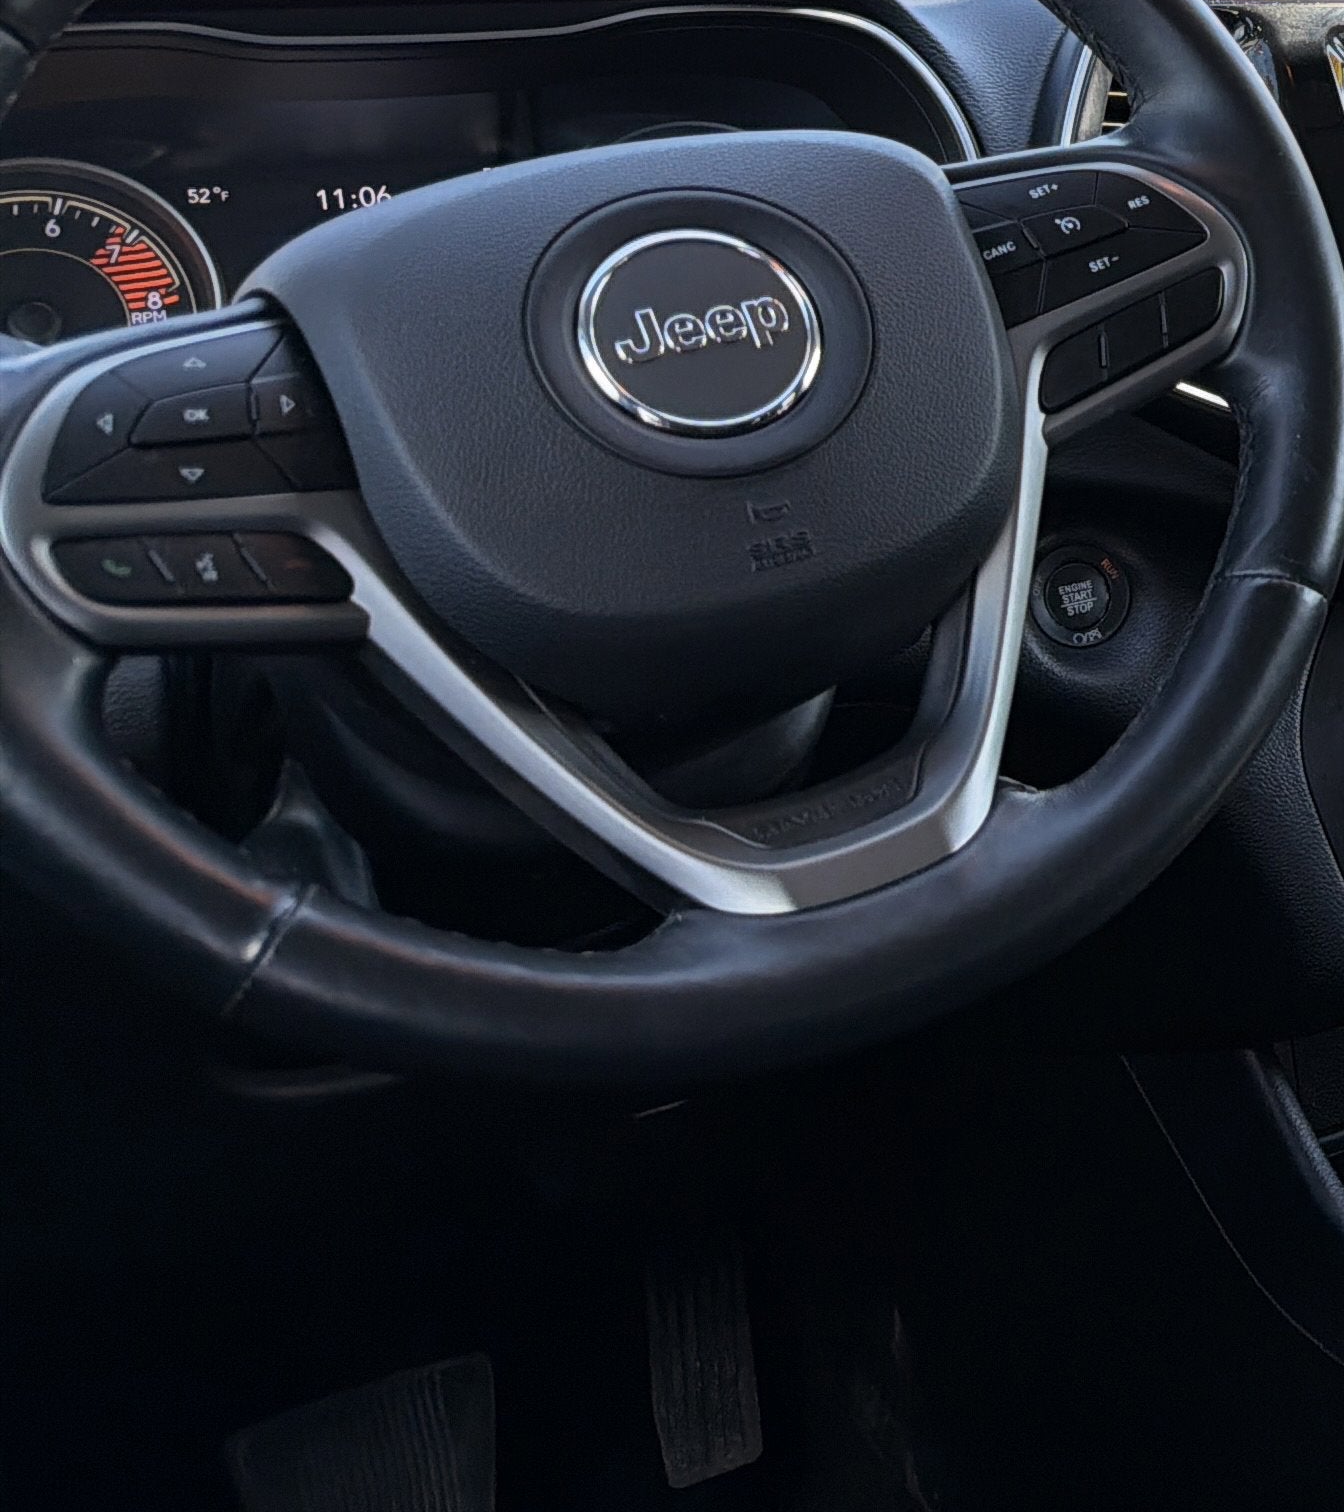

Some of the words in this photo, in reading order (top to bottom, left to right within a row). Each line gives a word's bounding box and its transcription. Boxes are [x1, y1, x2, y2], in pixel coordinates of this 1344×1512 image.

[315, 185, 392, 211] 11:06
[1127, 195, 1150, 210] RES
[44, 218, 61, 238] 6
[105, 245, 120, 263] 7
[982, 241, 1017, 261] CANC
[147, 291, 163, 310] 8
[131, 310, 167, 325] RPM
[614, 296, 789, 364] Jeep
[182, 408, 210, 424] OK
[1101, 557, 1120, 580] RUN
[1058, 579, 1093, 596] ENGINE
[1061, 589, 1093, 604] START
[1066, 602, 1094, 616] STOP
